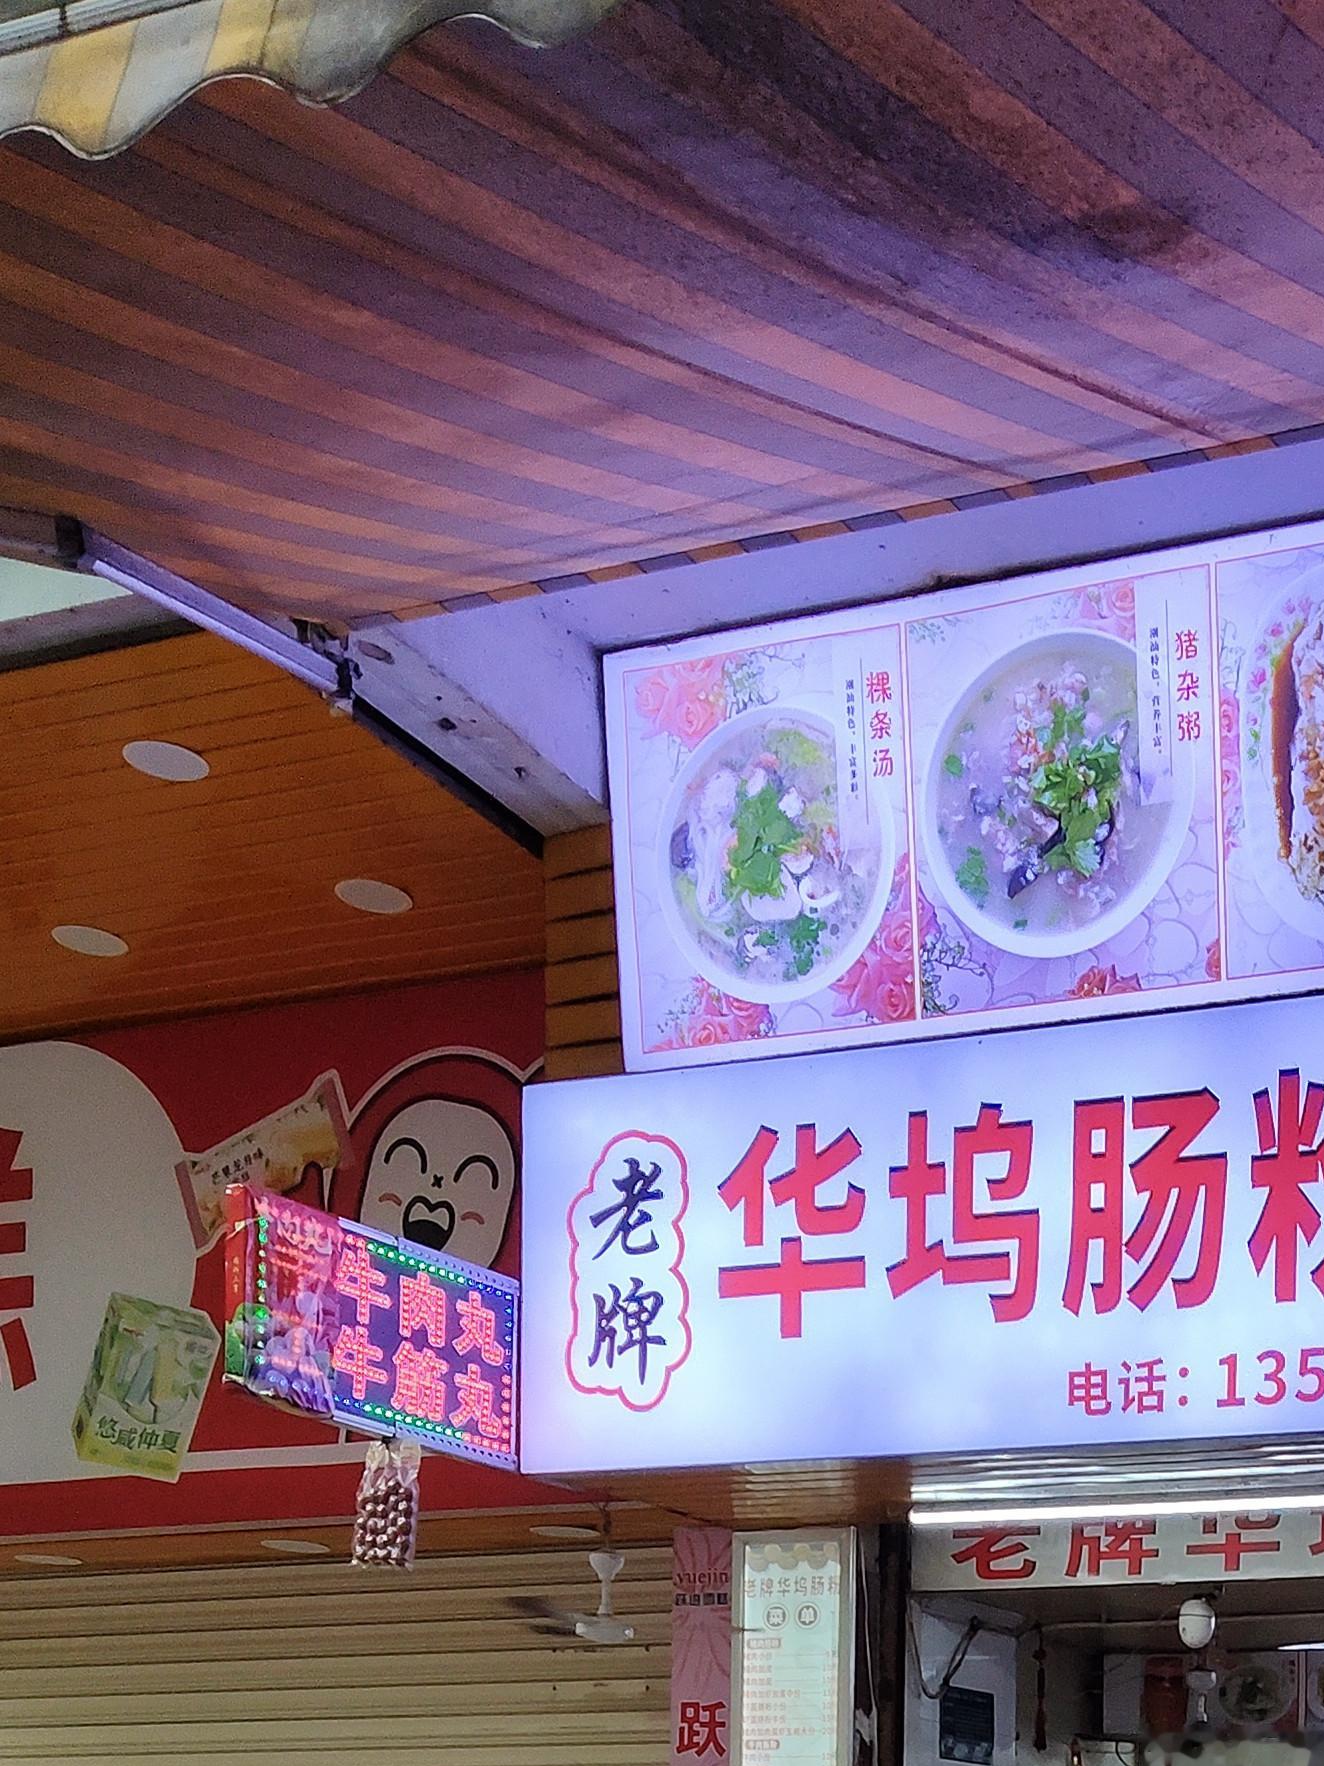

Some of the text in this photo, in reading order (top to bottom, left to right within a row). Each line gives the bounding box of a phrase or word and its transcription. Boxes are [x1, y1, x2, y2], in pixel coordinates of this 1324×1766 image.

[865, 670, 895, 778] 粿条汤
[1175, 628, 1201, 743] 猪杂粥
[333, 1246, 506, 1367] 牛肉丸
[589, 1157, 667, 1386] 老牌
[331, 1323, 501, 1438] 牛筋丸
